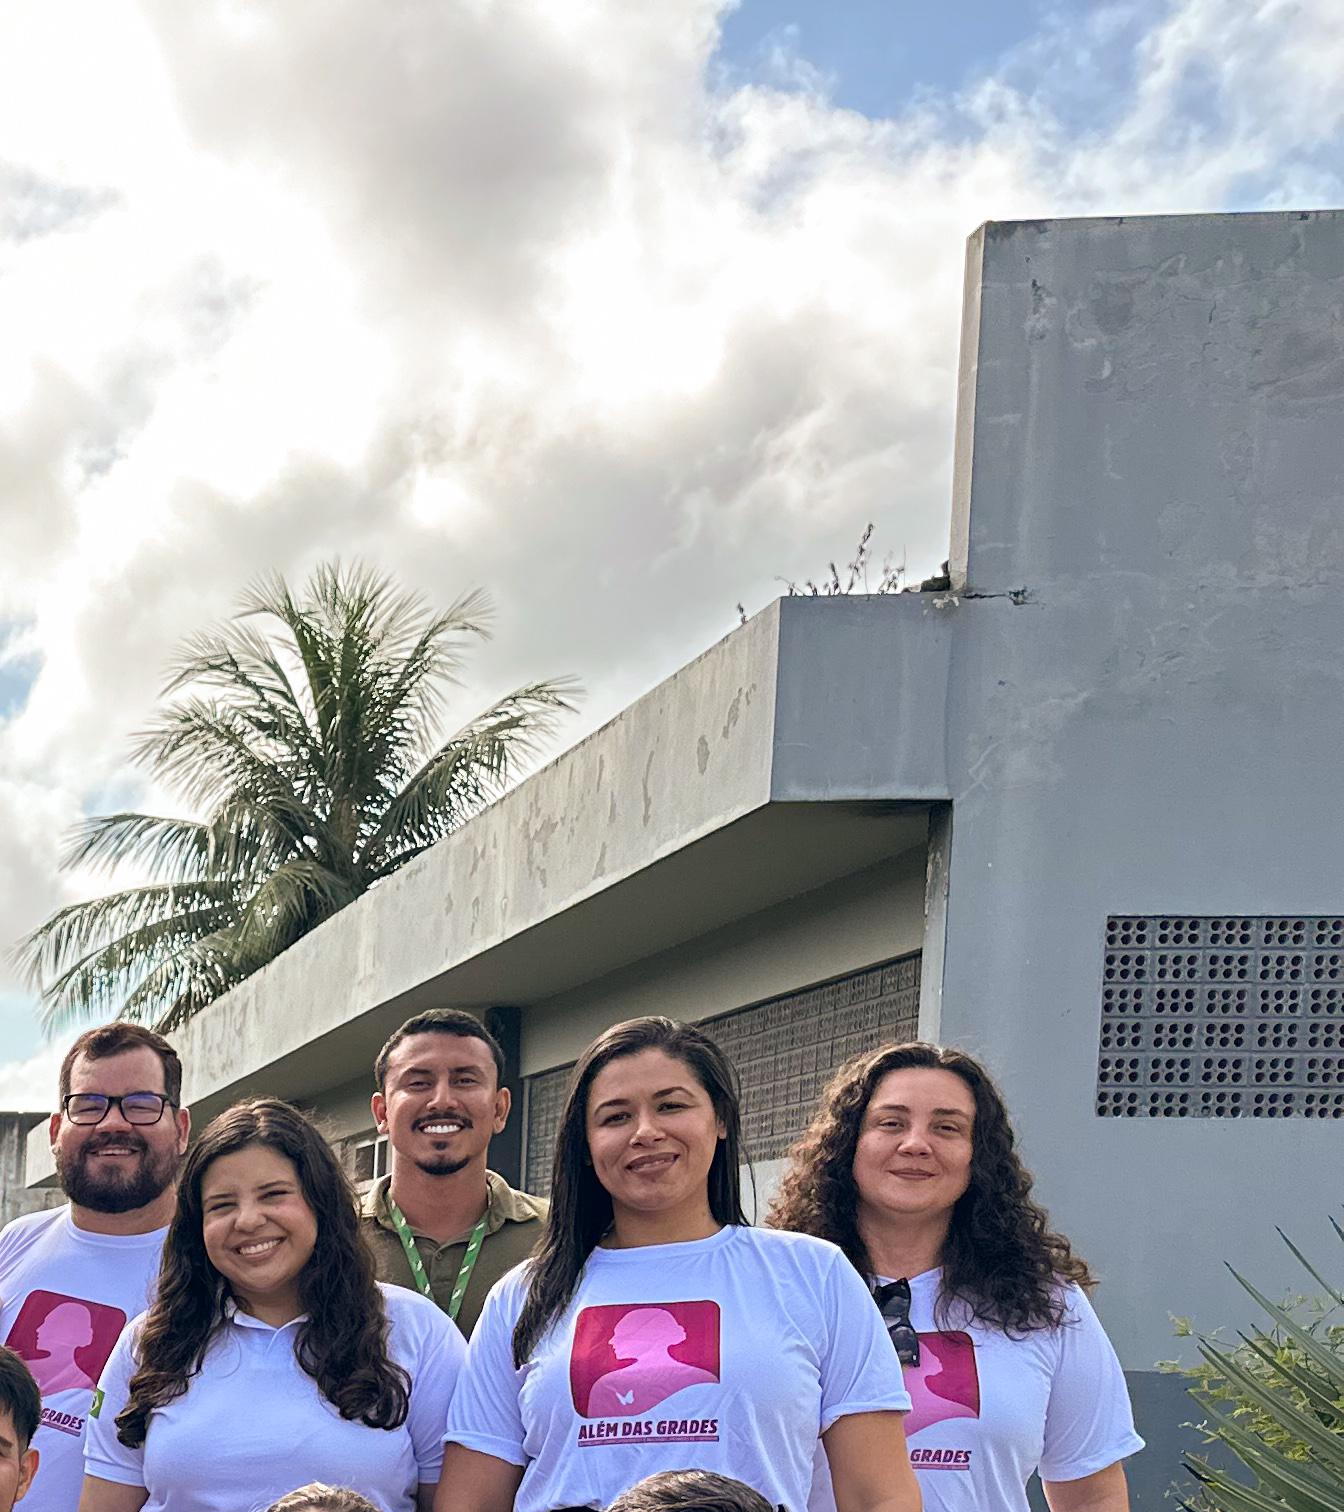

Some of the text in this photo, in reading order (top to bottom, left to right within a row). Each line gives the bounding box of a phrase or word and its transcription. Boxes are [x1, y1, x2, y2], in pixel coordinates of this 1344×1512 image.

[41, 1407, 86, 1430] GRADES
[578, 1419, 719, 1440] ALÉM DAS GRADES
[910, 1448, 972, 1463] GRADES
